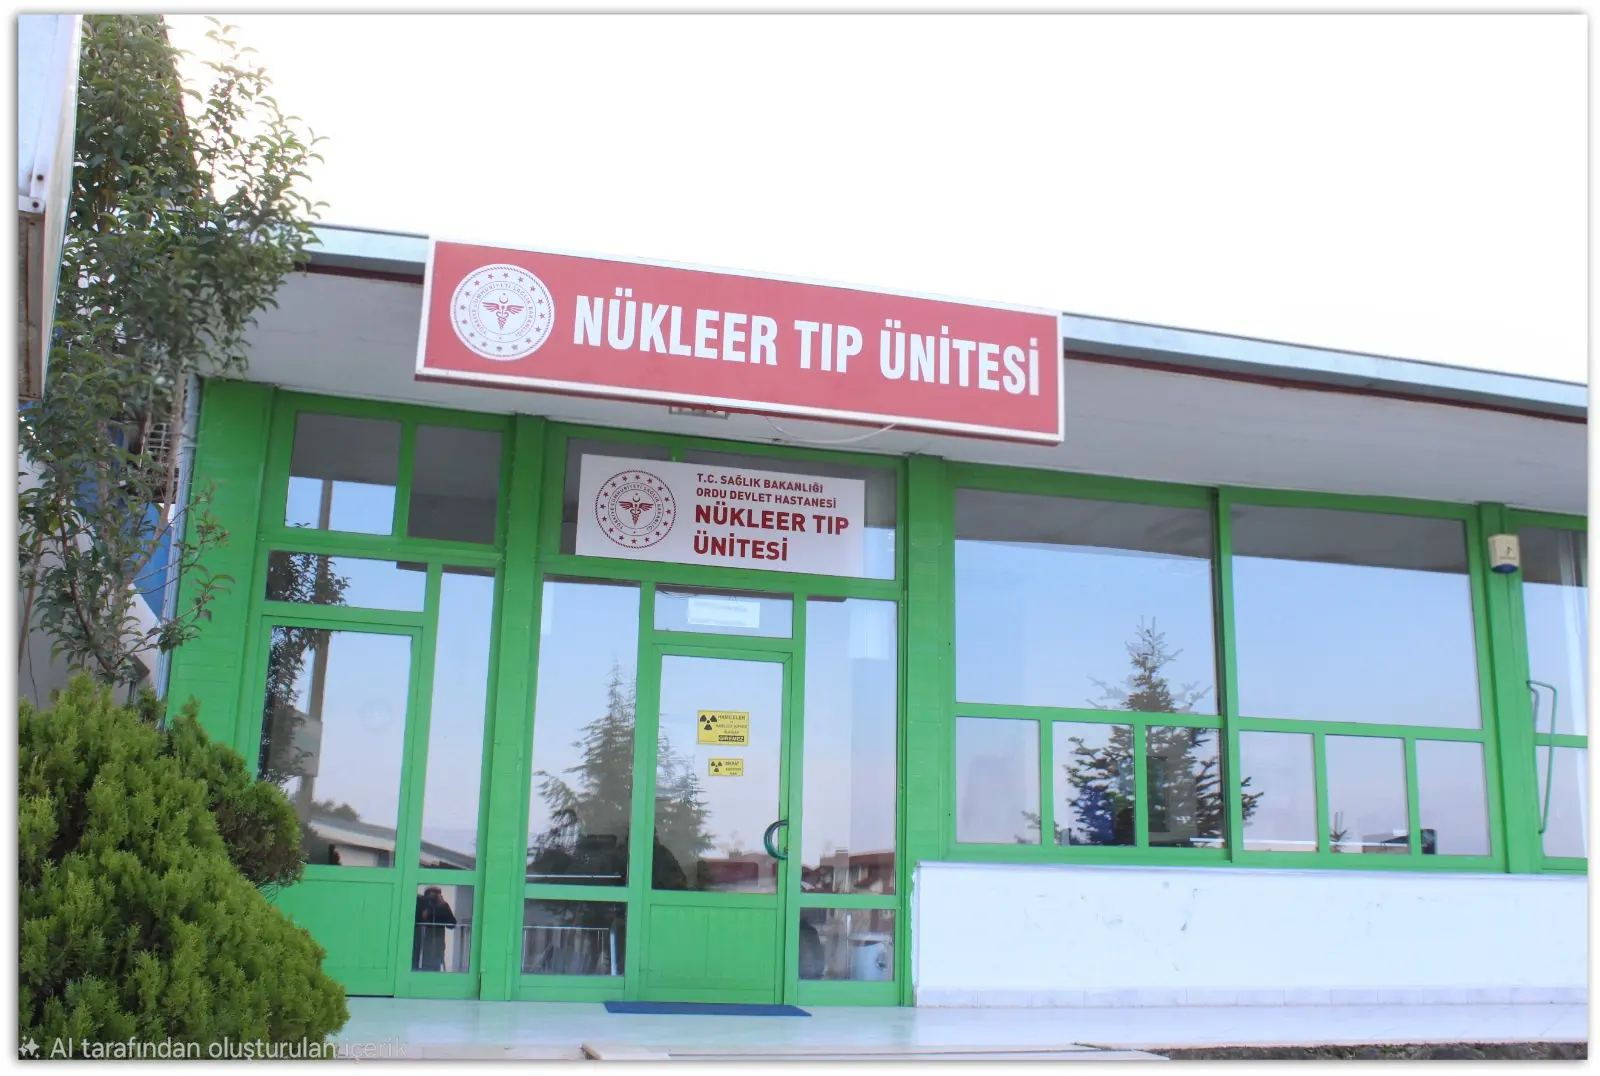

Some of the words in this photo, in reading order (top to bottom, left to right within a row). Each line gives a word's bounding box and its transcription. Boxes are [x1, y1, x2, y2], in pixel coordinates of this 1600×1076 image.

[573, 288, 778, 366] NÜKLEER
[795, 321, 863, 373] TIP
[879, 319, 1039, 396] ÜNİTESİ
[696, 487, 727, 498] ORDU
[729, 490, 772, 502] DEVLET
[774, 494, 837, 509] HASTANESİ
[697, 473, 718, 483] T.C.
[720, 475, 761, 488] SAĞLIK
[764, 479, 824, 493] BAKANLIĞI
[695, 501, 805, 532] NÜKLEER
[812, 515, 850, 535] TIP
[693, 530, 788, 561] ÜNİTESİ
